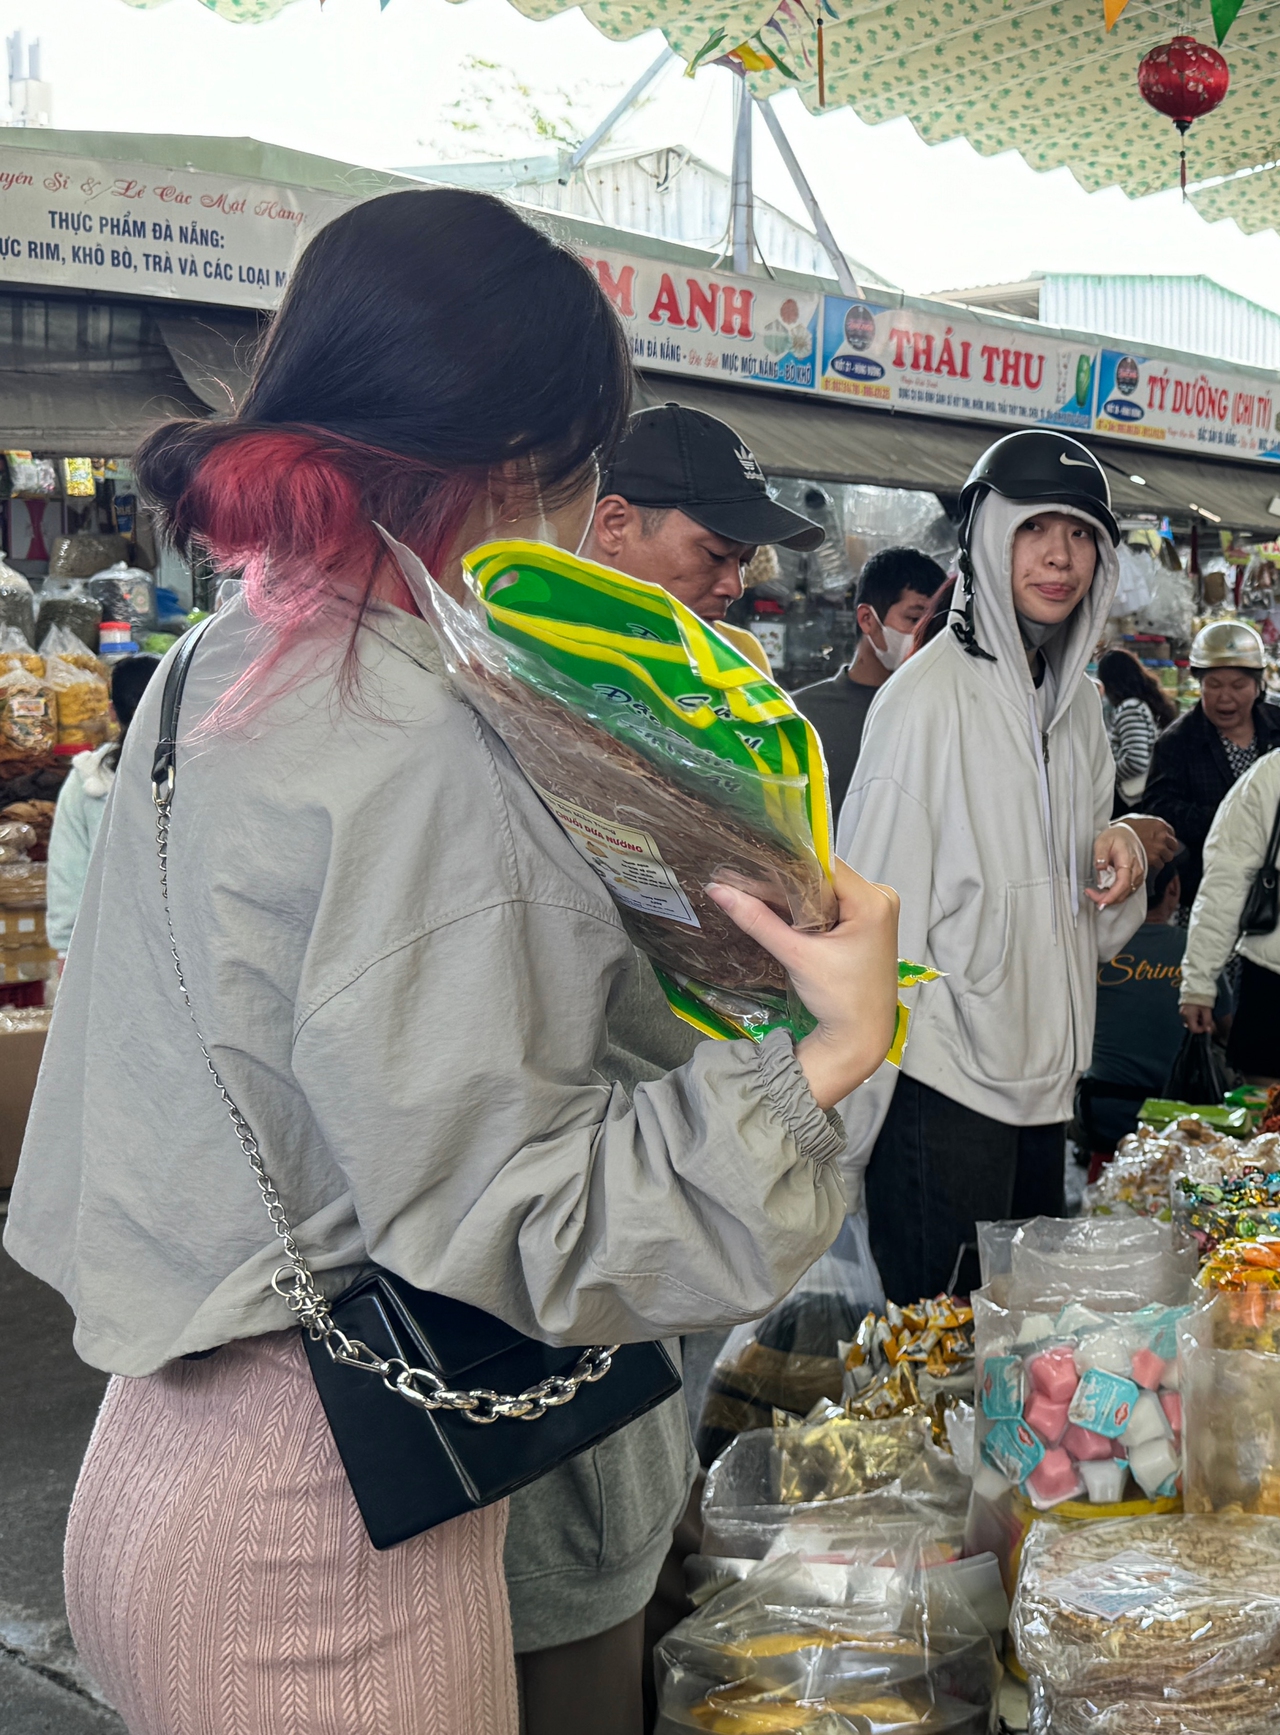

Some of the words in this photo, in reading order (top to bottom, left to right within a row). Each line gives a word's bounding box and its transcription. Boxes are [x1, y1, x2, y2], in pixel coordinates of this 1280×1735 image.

[48, 210, 93, 236] THỰC
[99, 211, 147, 240] PHẨM
[152, 217, 174, 243] ĐÀ
[179, 221, 225, 249] NẴNG:
[28, 241, 66, 265] RIM,
[72, 242, 105, 267] KHÔ
[111, 246, 138, 273] BÒ,
[143, 250, 173, 275] TRÀ
[178, 255, 199, 278] VÀ
[203, 258, 233, 282] CÁC
[238, 265, 270, 290] LOẠI
[648, 273, 755, 339] ANH
[890, 326, 971, 379] THÁI
[981, 344, 1046, 390] THU
[1172, 374, 1229, 421] DƯỠNG
